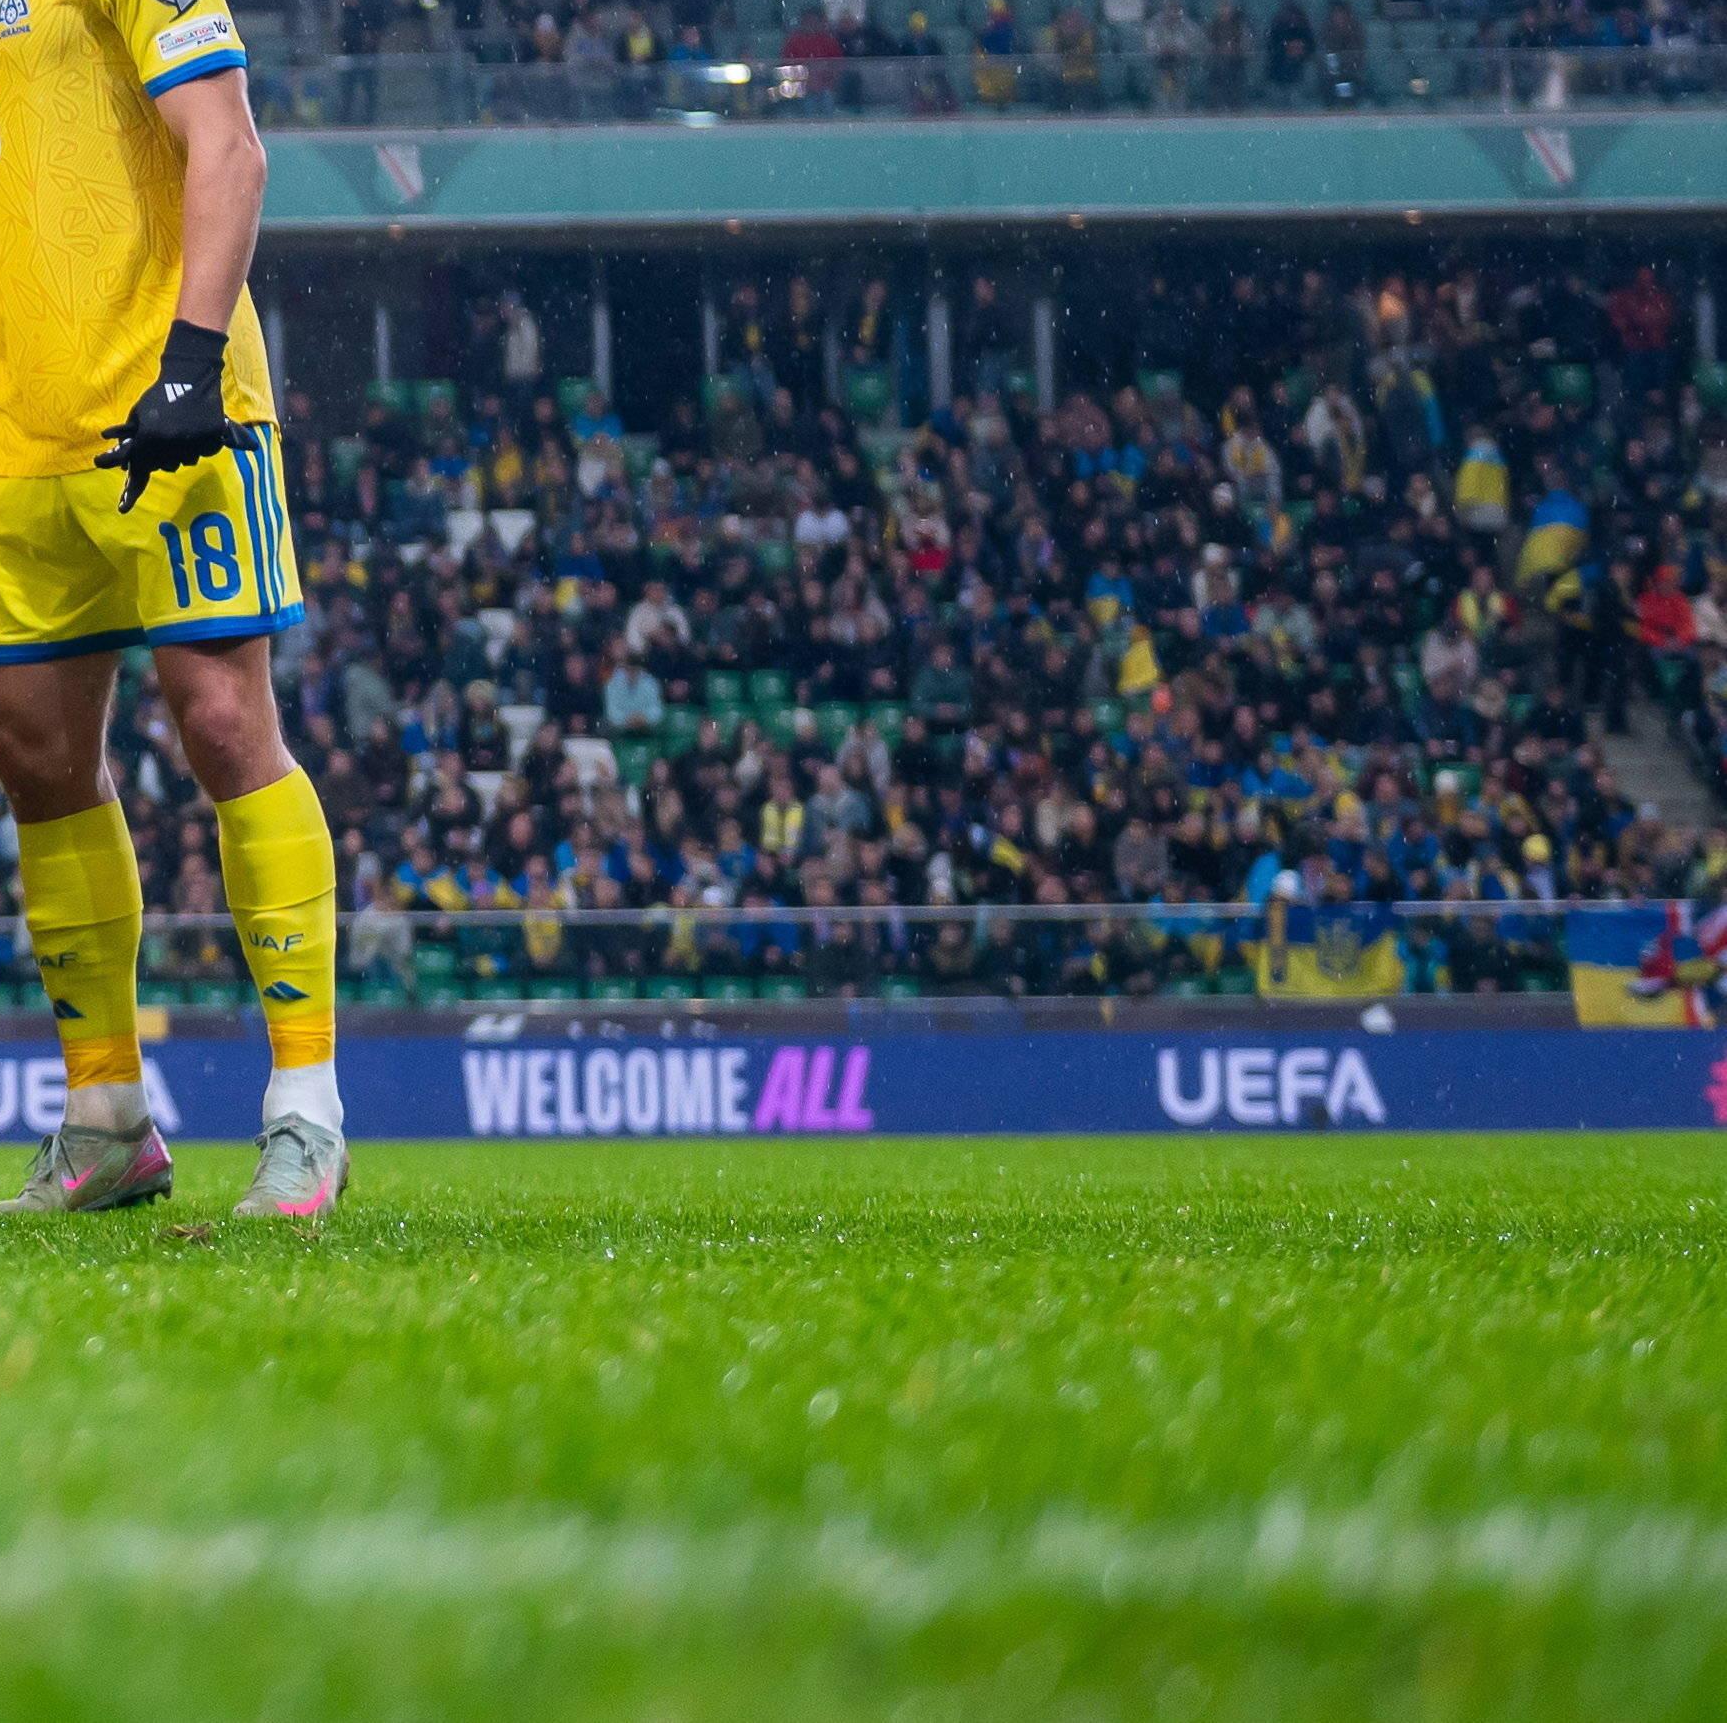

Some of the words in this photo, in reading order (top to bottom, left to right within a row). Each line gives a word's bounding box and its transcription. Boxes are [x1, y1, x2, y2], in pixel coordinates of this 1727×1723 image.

[159, 510, 242, 609] 18
[248, 931, 304, 952] UAF
[462, 1046, 749, 1135] WELCOME
[753, 1045, 874, 1133] ALL
[1157, 1048, 1387, 1125] UEFA
